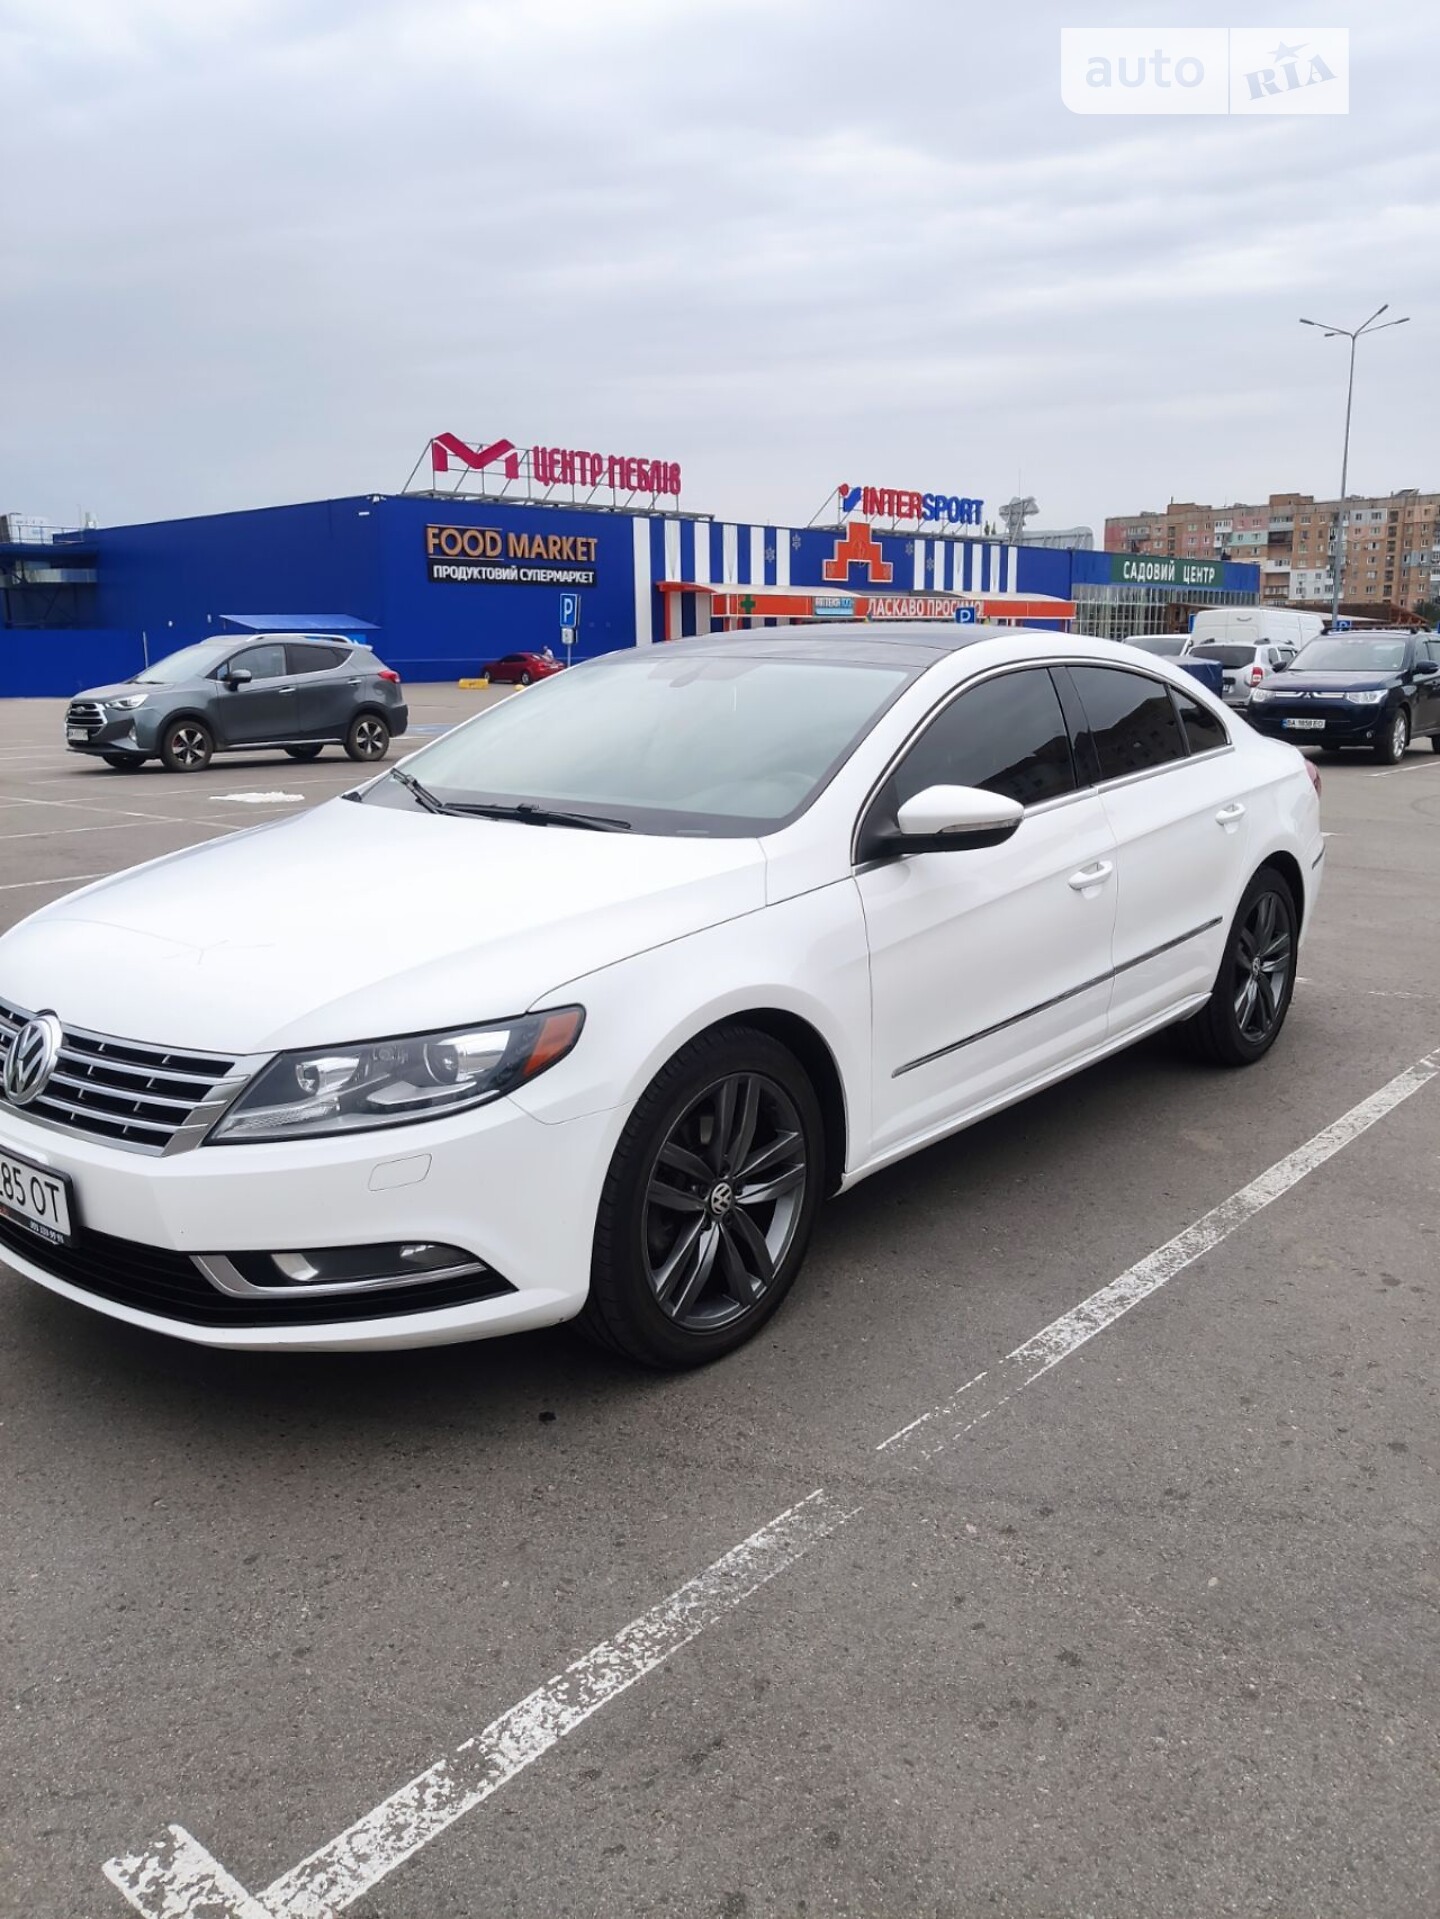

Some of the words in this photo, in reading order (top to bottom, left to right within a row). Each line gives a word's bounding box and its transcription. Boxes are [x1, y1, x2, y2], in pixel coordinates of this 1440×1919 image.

[532, 445, 602, 487] ЦЕНТР
[608, 454, 682, 496] МЕБЛІВ
[863, 486, 984, 525] INTERSPORT
[426, 526, 503, 558] FOOD
[507, 532, 598, 562] MARKET
[432, 563, 518, 582] ПРОДУКТОВИЙ
[519, 568, 595, 585] СУПЕРМАРКЕТ
[1123, 559, 1175, 583] САДОВИЙ
[1183, 565, 1216, 585] ЦЕНТР
[563, 598, 573, 623] P
[867, 598, 925, 617] ЛАСКАВО
[960, 609, 971, 623] P
[0, 1161, 26, 1207] 85
[30, 1176, 59, 1223] OT
